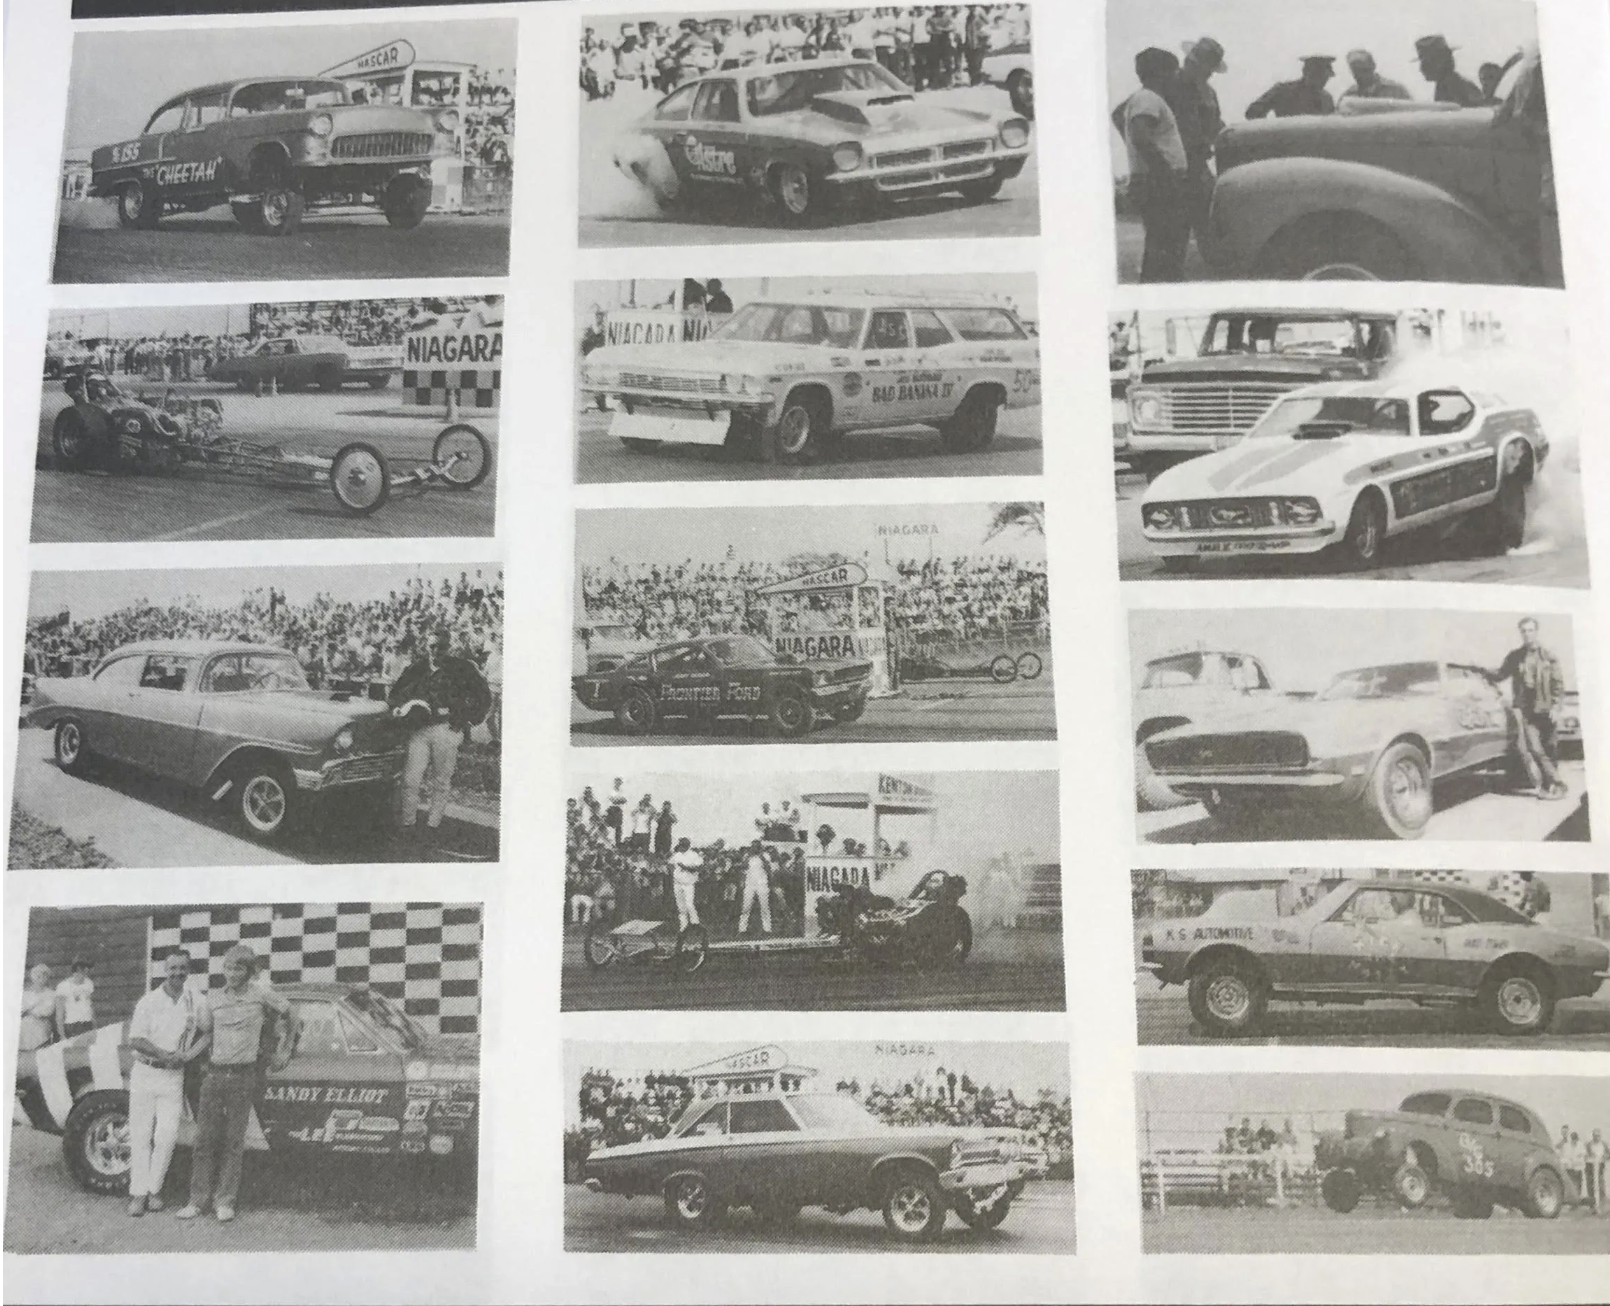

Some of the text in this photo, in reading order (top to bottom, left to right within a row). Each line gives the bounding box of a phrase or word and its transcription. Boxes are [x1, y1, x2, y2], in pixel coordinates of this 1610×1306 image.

[358, 47, 398, 68] NASCAR
[407, 333, 503, 363] NIAGARA
[872, 386, 897, 403] BAD
[877, 523, 940, 537] NIAGARA
[802, 567, 848, 586] NASCAR
[775, 634, 856, 658] NIAGARA
[726, 681, 761, 701] FORD
[1193, 926, 1254, 941] AUTOMOTIVE
[264, 1086, 322, 1103] SANDY
[322, 1086, 390, 1105] ELLIOT
